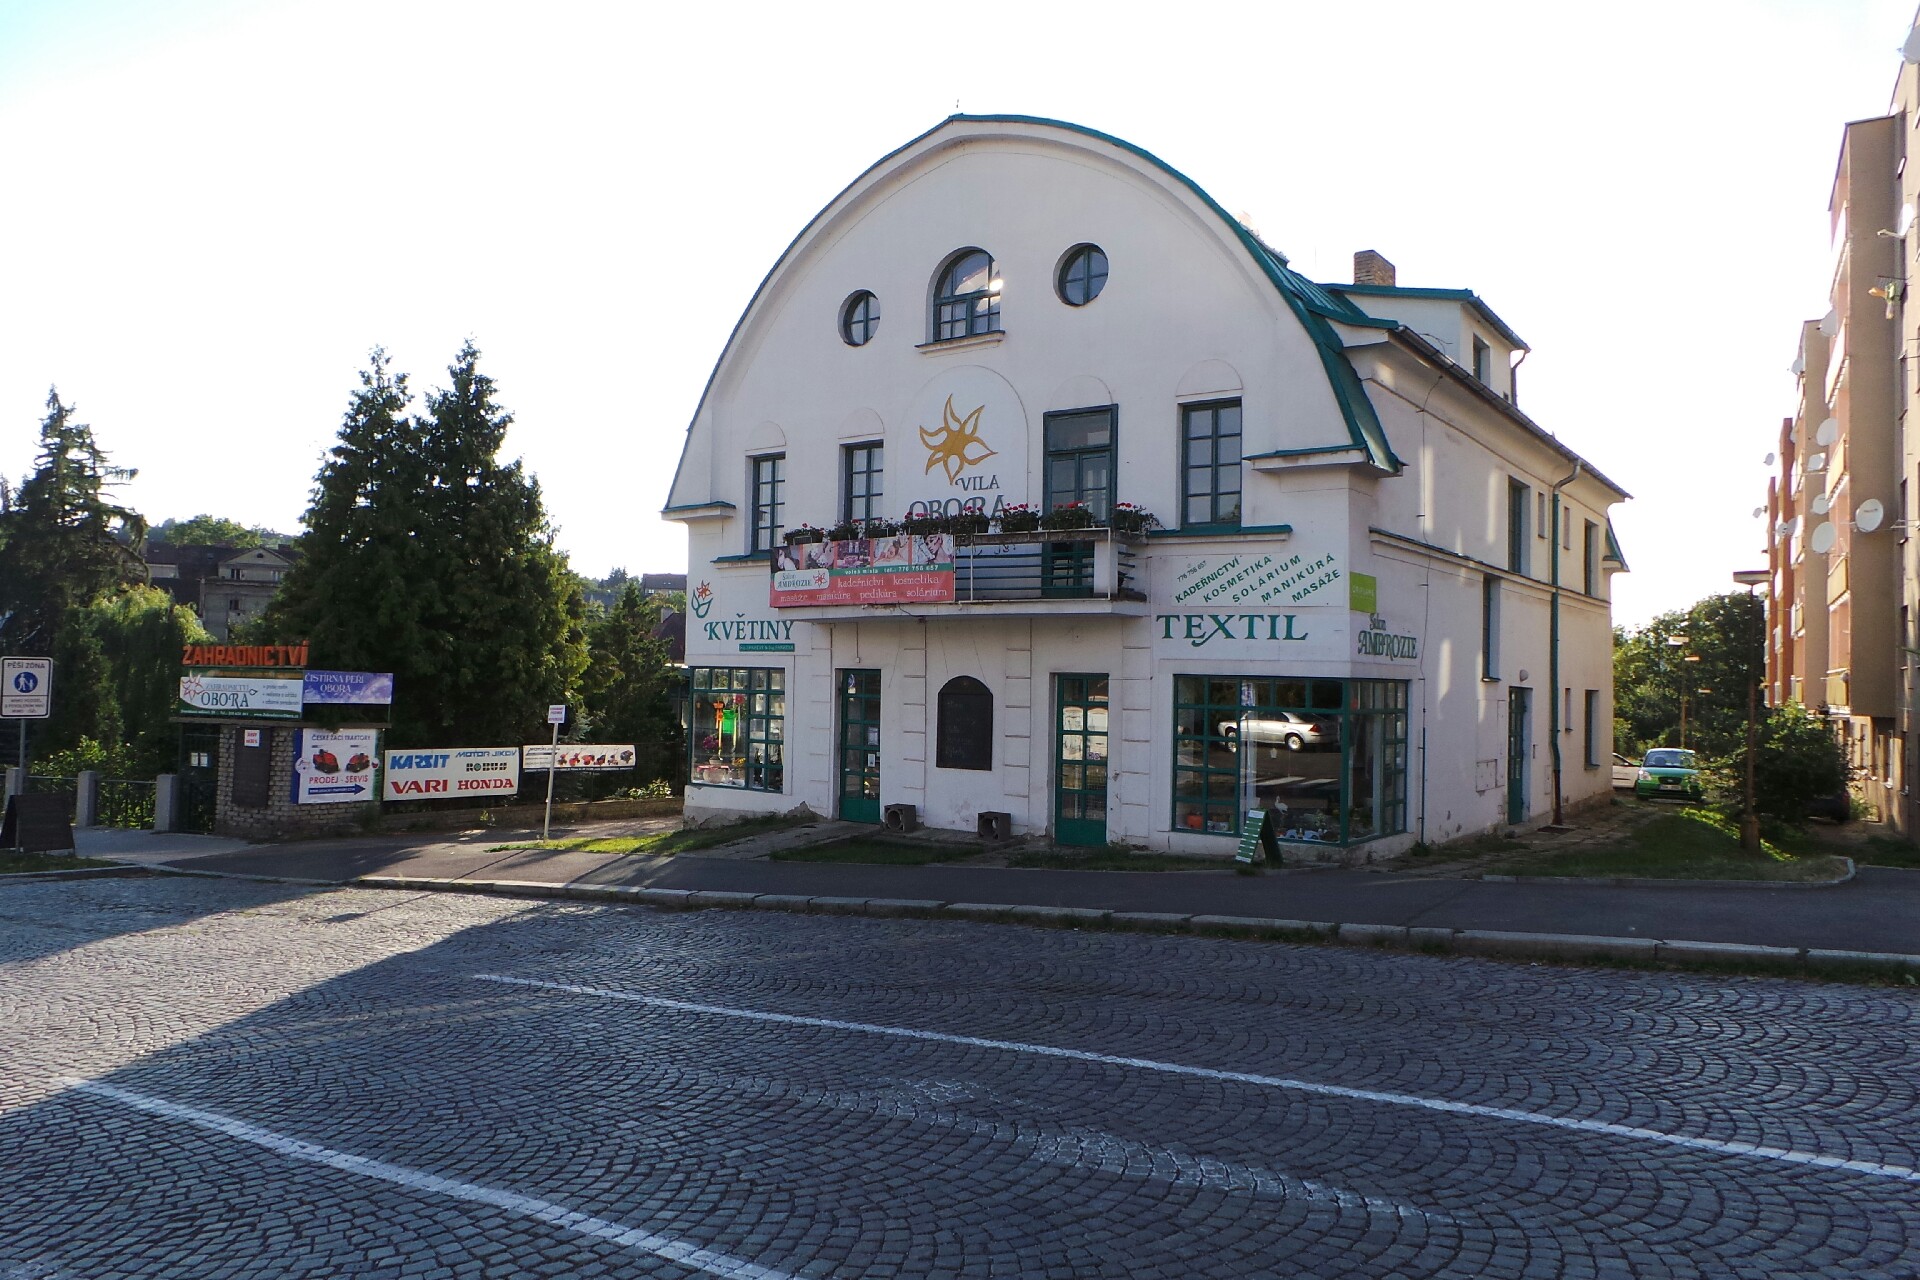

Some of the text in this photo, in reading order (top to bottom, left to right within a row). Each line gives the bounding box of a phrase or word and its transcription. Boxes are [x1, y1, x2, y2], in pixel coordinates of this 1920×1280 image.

[955, 474, 1000, 491] VILA
[893, 574, 940, 586] kosmetika
[1175, 556, 1240, 603] KADEŘNICTVÍ
[1203, 556, 1272, 602] KOSMETIKA
[1232, 555, 1301, 602] SOLÁRIUM
[1261, 553, 1335, 602] MANIKÚRA
[1292, 569, 1340, 602] MASÁŽE
[906, 584, 947, 597] solárium
[704, 613, 795, 640] KVĚTINY
[1156, 614, 1308, 647] TEXTIL
[182, 640, 310, 666] ZAHRADNICTVÍ
[1358, 630, 1418, 661] AMBROZIE
[304, 672, 344, 683] ČISTÍRNA
[320, 684, 351, 693] OBORA
[201, 692, 249, 709] OBORA
[390, 754, 450, 770] KARSIT
[308, 776, 338, 784] PRODEJ
[345, 775, 368, 783] SERVIS
[390, 778, 514, 794] VARI HONDA
